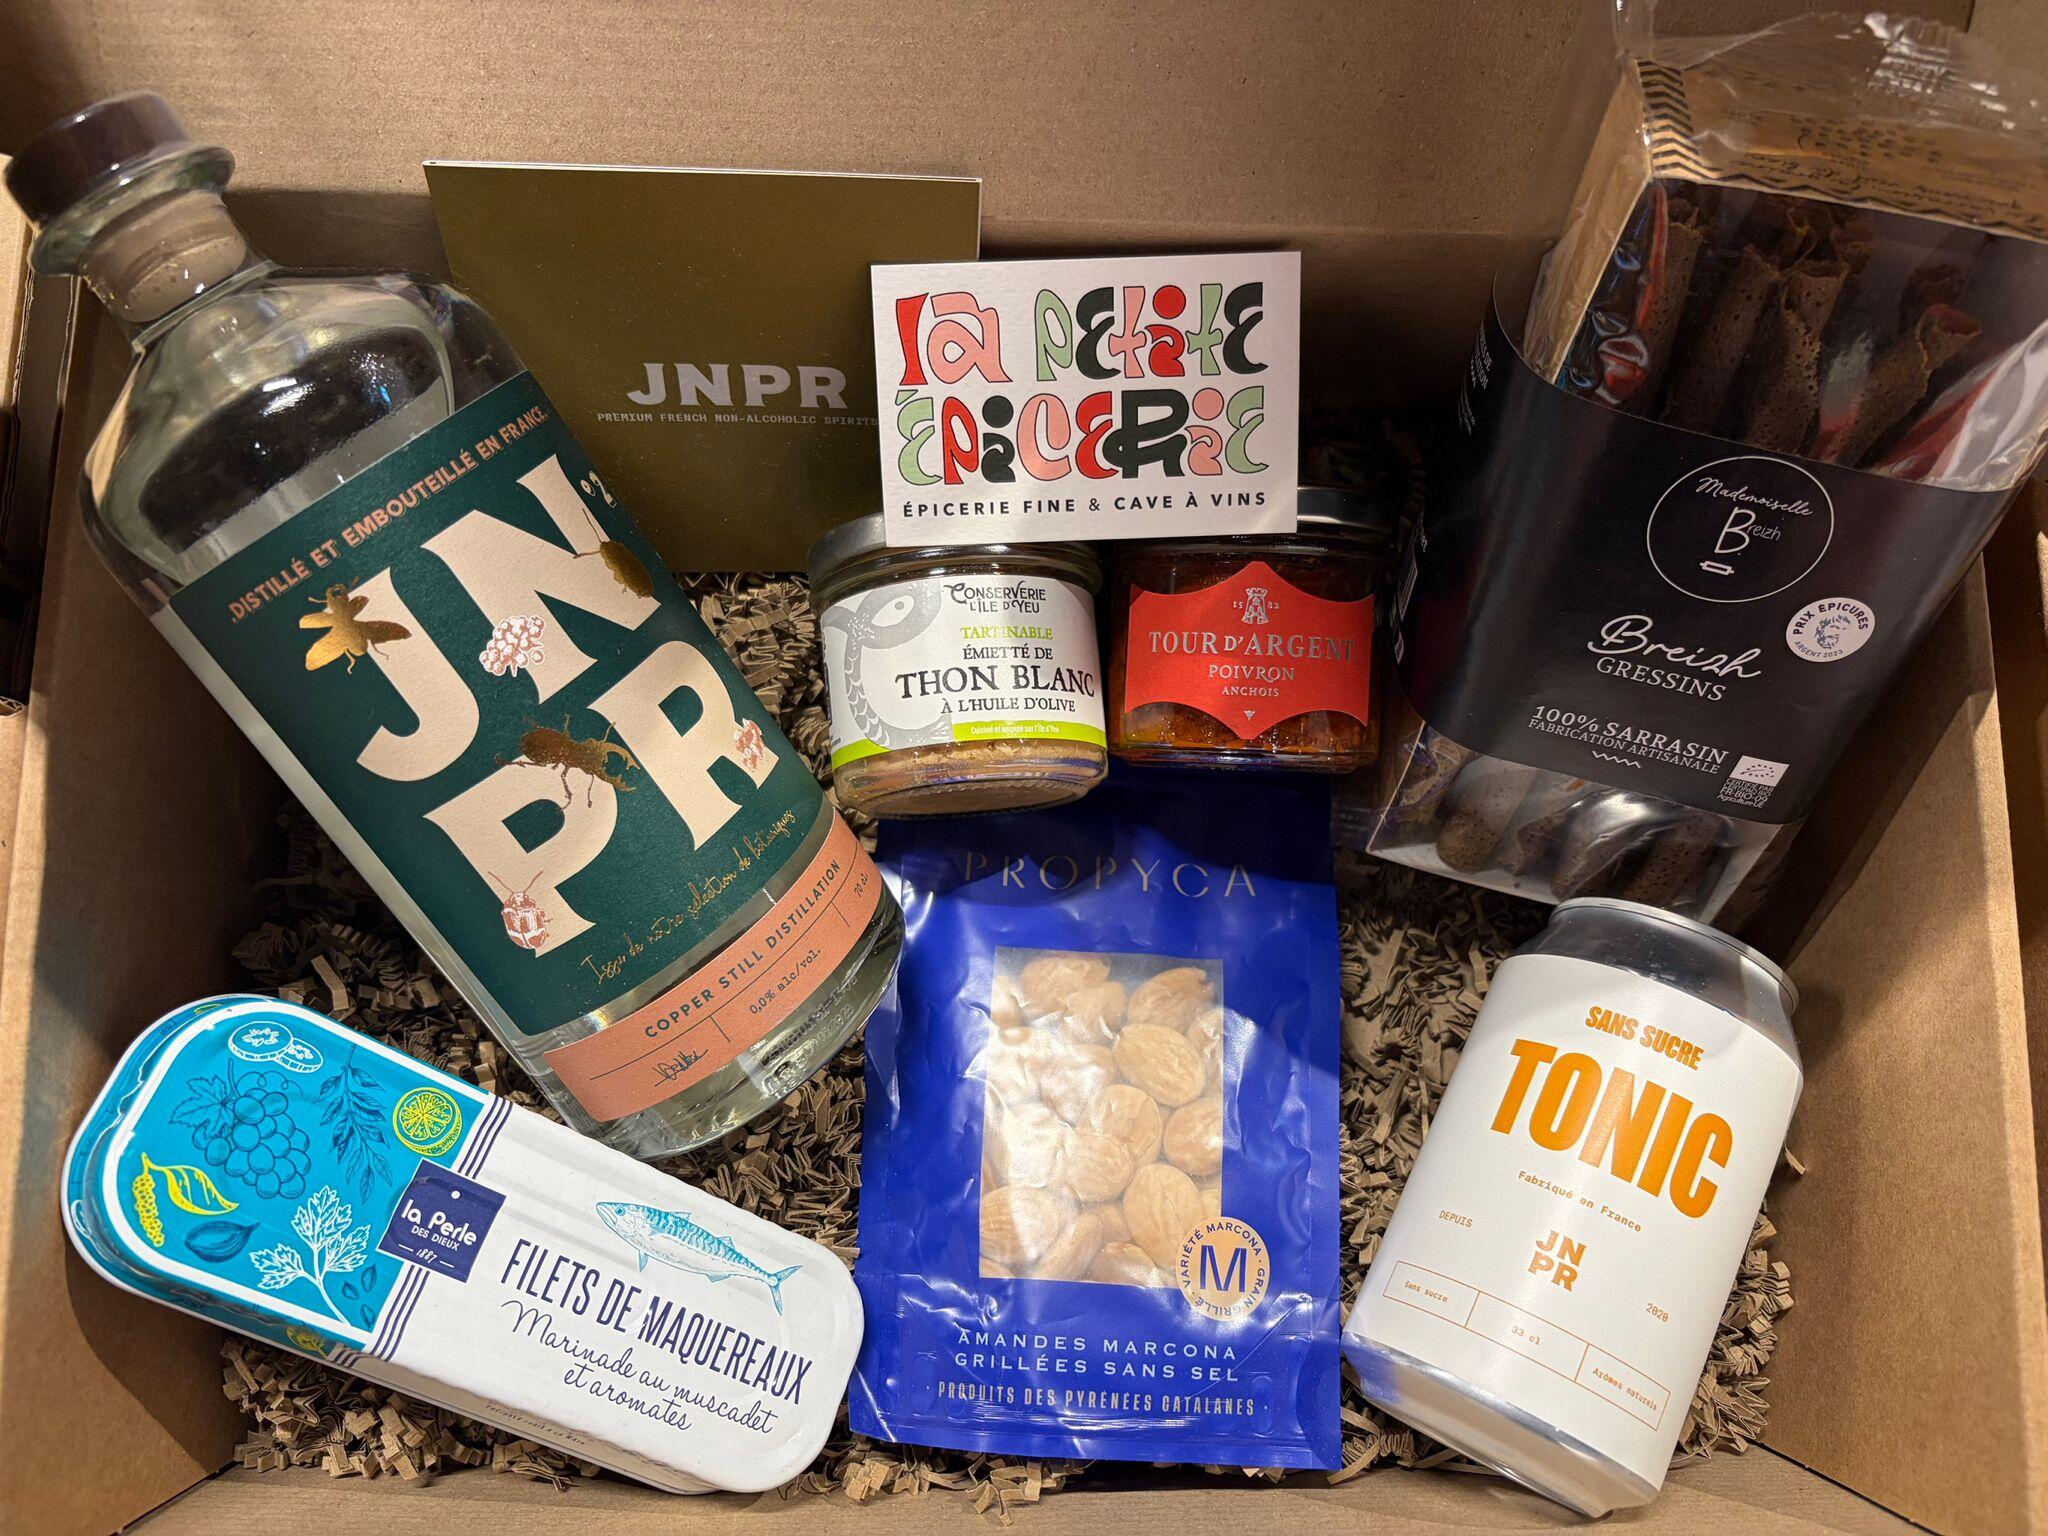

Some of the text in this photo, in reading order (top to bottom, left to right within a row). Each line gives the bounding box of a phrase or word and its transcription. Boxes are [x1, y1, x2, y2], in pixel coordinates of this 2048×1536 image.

[626, 362, 848, 409] JNPR
[597, 411, 879, 427] PREMIUM FRENCH NON-ALCOHOLIC SPIRITS
[310, 539, 340, 568] ET
[341, 448, 480, 548] EMBOUTEILLÉ
[475, 435, 502, 463] EN
[903, 491, 1266, 518] ÉPICERIE FINE & CAVE À VINS
[1695, 477, 1813, 516] Mademoiselle
[1714, 506, 1781, 553] Breizh
[355, 454, 662, 783] JN
[1793, 611, 1815, 635] PRIX
[963, 643, 1053, 660] ÉMIETTÉ DE
[1150, 631, 1355, 662] TOUR D'ARGENT
[1587, 615, 1762, 678] Breizh
[1794, 640, 1821, 658] ARGENT
[895, 664, 1095, 699] THON BLANC
[1209, 665, 1295, 683] POIVRON
[1221, 686, 1280, 697] ANCHOIS
[1596, 656, 1726, 701] GRESSINS
[941, 698, 1076, 714] À L'HUILE D'OLIVE
[1528, 718, 1721, 775] FABRICATION ARTISANALE
[1532, 705, 1729, 765] 100% SARRASIN
[423, 640, 781, 958] PR
[966, 851, 1257, 898] PROPYCA
[644, 988, 714, 1040] COPPER
[718, 950, 764, 990] STILL
[766, 858, 842, 951] DISTILLATION
[749, 989, 777, 1017] 0,0%
[1585, 1005, 1705, 1071] SANS SUCRE
[1490, 1038, 1733, 1218] TONIC
[401, 1199, 422, 1225] la
[1438, 1209, 1473, 1228] DEPUIS
[1518, 1170, 1641, 1232] Fabriqué en France
[411, 1225, 460, 1251] DES DIEUX
[1535, 1230, 1587, 1268] JN
[1181, 1229, 1203, 1288] VARIÉTÉ
[1206, 1222, 1262, 1256] MARCONA
[1244, 1268, 1265, 1308] GRAIN
[1200, 1245, 1247, 1293] M
[1528, 1250, 1580, 1292] PR
[1404, 1279, 1448, 1303] Sans sucre
[501, 1238, 813, 1405] FILETS DE MAQUEREAUX
[1511, 1325, 1526, 1337] 33
[1645, 1301, 1669, 1323] 2020
[958, 1329, 1237, 1360] AMANDES MARCONA
[501, 1300, 779, 1434] Marinade au muscadet
[954, 1352, 1239, 1383] GRILLÉES SANS SEL
[564, 1361, 588, 1389] et
[589, 1381, 697, 1431] aromates
[937, 1380, 1255, 1417] PRODUITS DES PYRÉNÉES CATALANES
[1626, 1387, 1657, 1411] naturels
